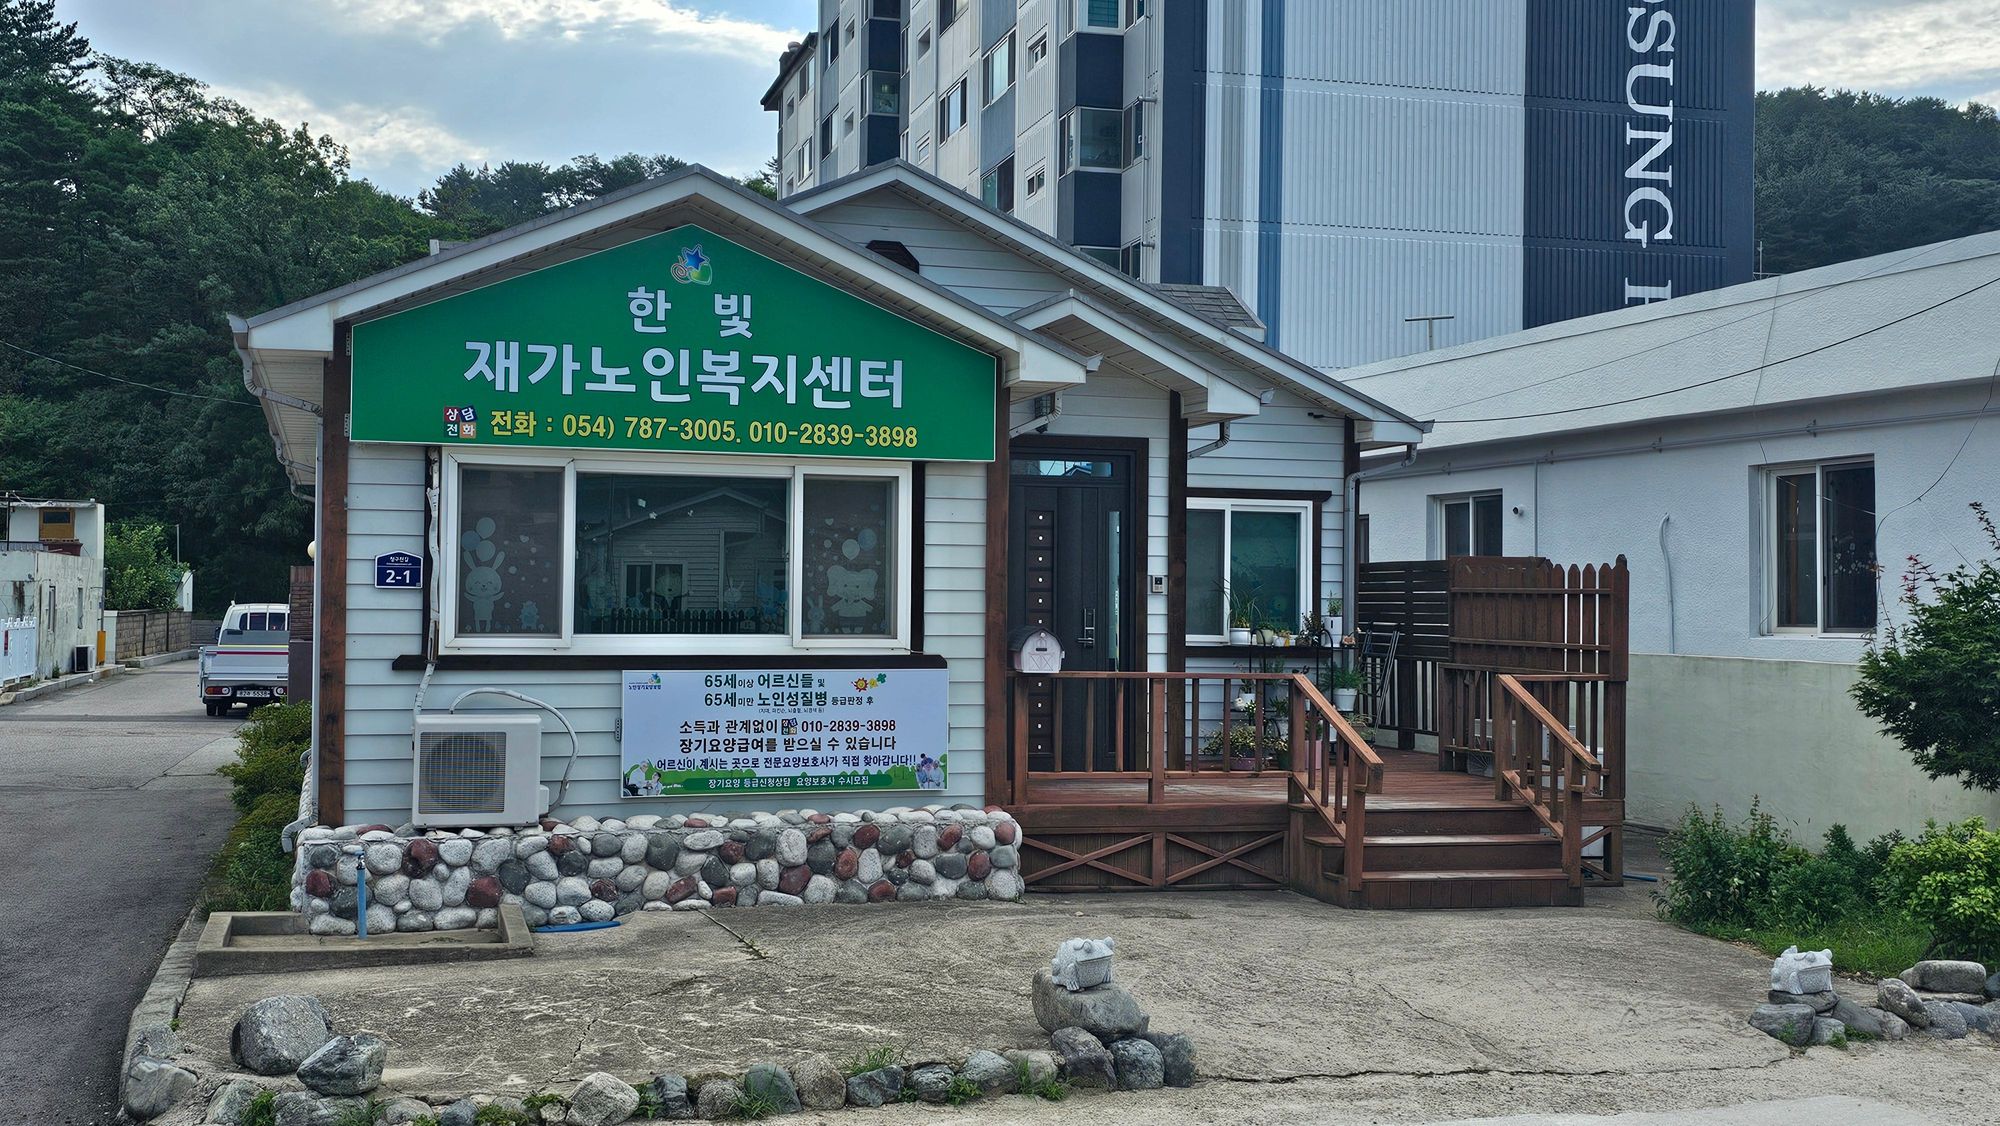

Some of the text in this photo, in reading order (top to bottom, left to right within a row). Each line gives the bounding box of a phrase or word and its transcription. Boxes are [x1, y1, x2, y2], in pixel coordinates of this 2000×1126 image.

[1624, 0, 1676, 249] SUNG
[627, 285, 753, 340] 한 빛
[463, 340, 905, 410] 재가노인복지센터
[446, 407, 474, 421] 상담
[446, 423, 475, 437] 전화
[489, 409, 538, 437] 전화
[562, 414, 615, 440] 054)
[749, 420, 919, 449] 010-2839-3898
[385, 569, 411, 584] 2-1
[757, 673, 814, 689] 어르신들
[817, 678, 826, 688] 및
[757, 691, 828, 707] 노인성질병
[831, 696, 864, 706] 등급판정
[866, 695, 875, 706] 후
[679, 719, 777, 735] 소득과 관계없이
[801, 719, 896, 733] 010-2839-3898
[679, 736, 897, 753] 장기요양급여를 받으실 수 있습니다
[657, 754, 917, 771] 어르신이 계시는 곳으로 전문요양보호사가 직접 찾아갑니다!!
[708, 775, 869, 788] 장기요양 등급신청상담 요양보호사 수시모집
